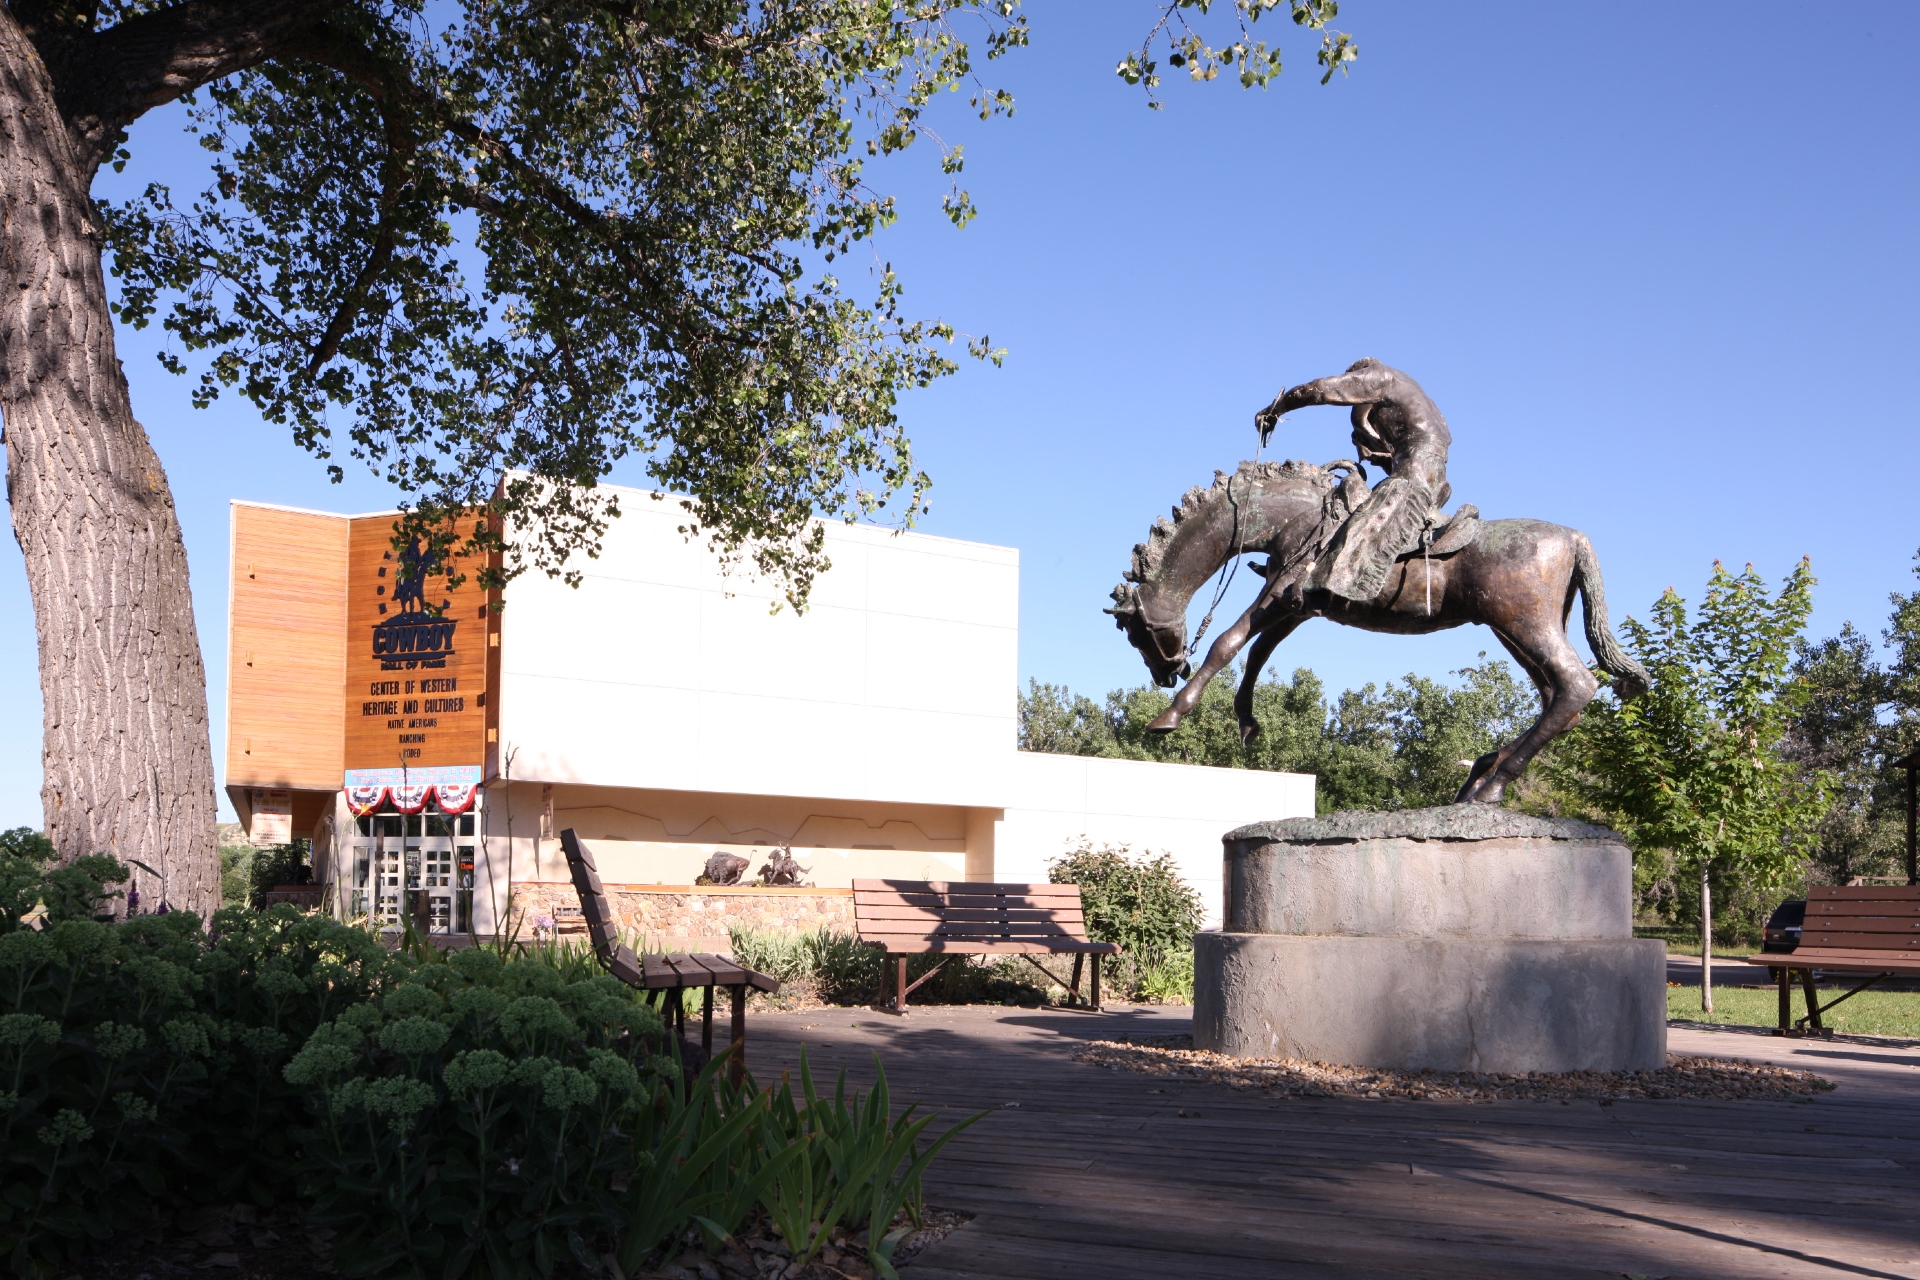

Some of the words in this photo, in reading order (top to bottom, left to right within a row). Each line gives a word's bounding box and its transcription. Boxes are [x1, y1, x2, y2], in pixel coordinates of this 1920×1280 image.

[373, 624, 456, 654] COWBOY
[381, 660, 404, 671] HALL
[406, 661, 418, 670] OF
[421, 659, 446, 669] FAME
[371, 681, 400, 696] CENTER
[405, 680, 415, 694] OF
[420, 678, 457, 693] WESTERN
[363, 701, 398, 716] HERITAGE
[403, 700, 418, 714] AND
[424, 697, 464, 713] CULTURES
[388, 719, 404, 729] NATIVE
[408, 718, 437, 728] AMERICANS
[399, 733, 425, 743] RANCHING
[403, 748, 420, 758] RODEO
